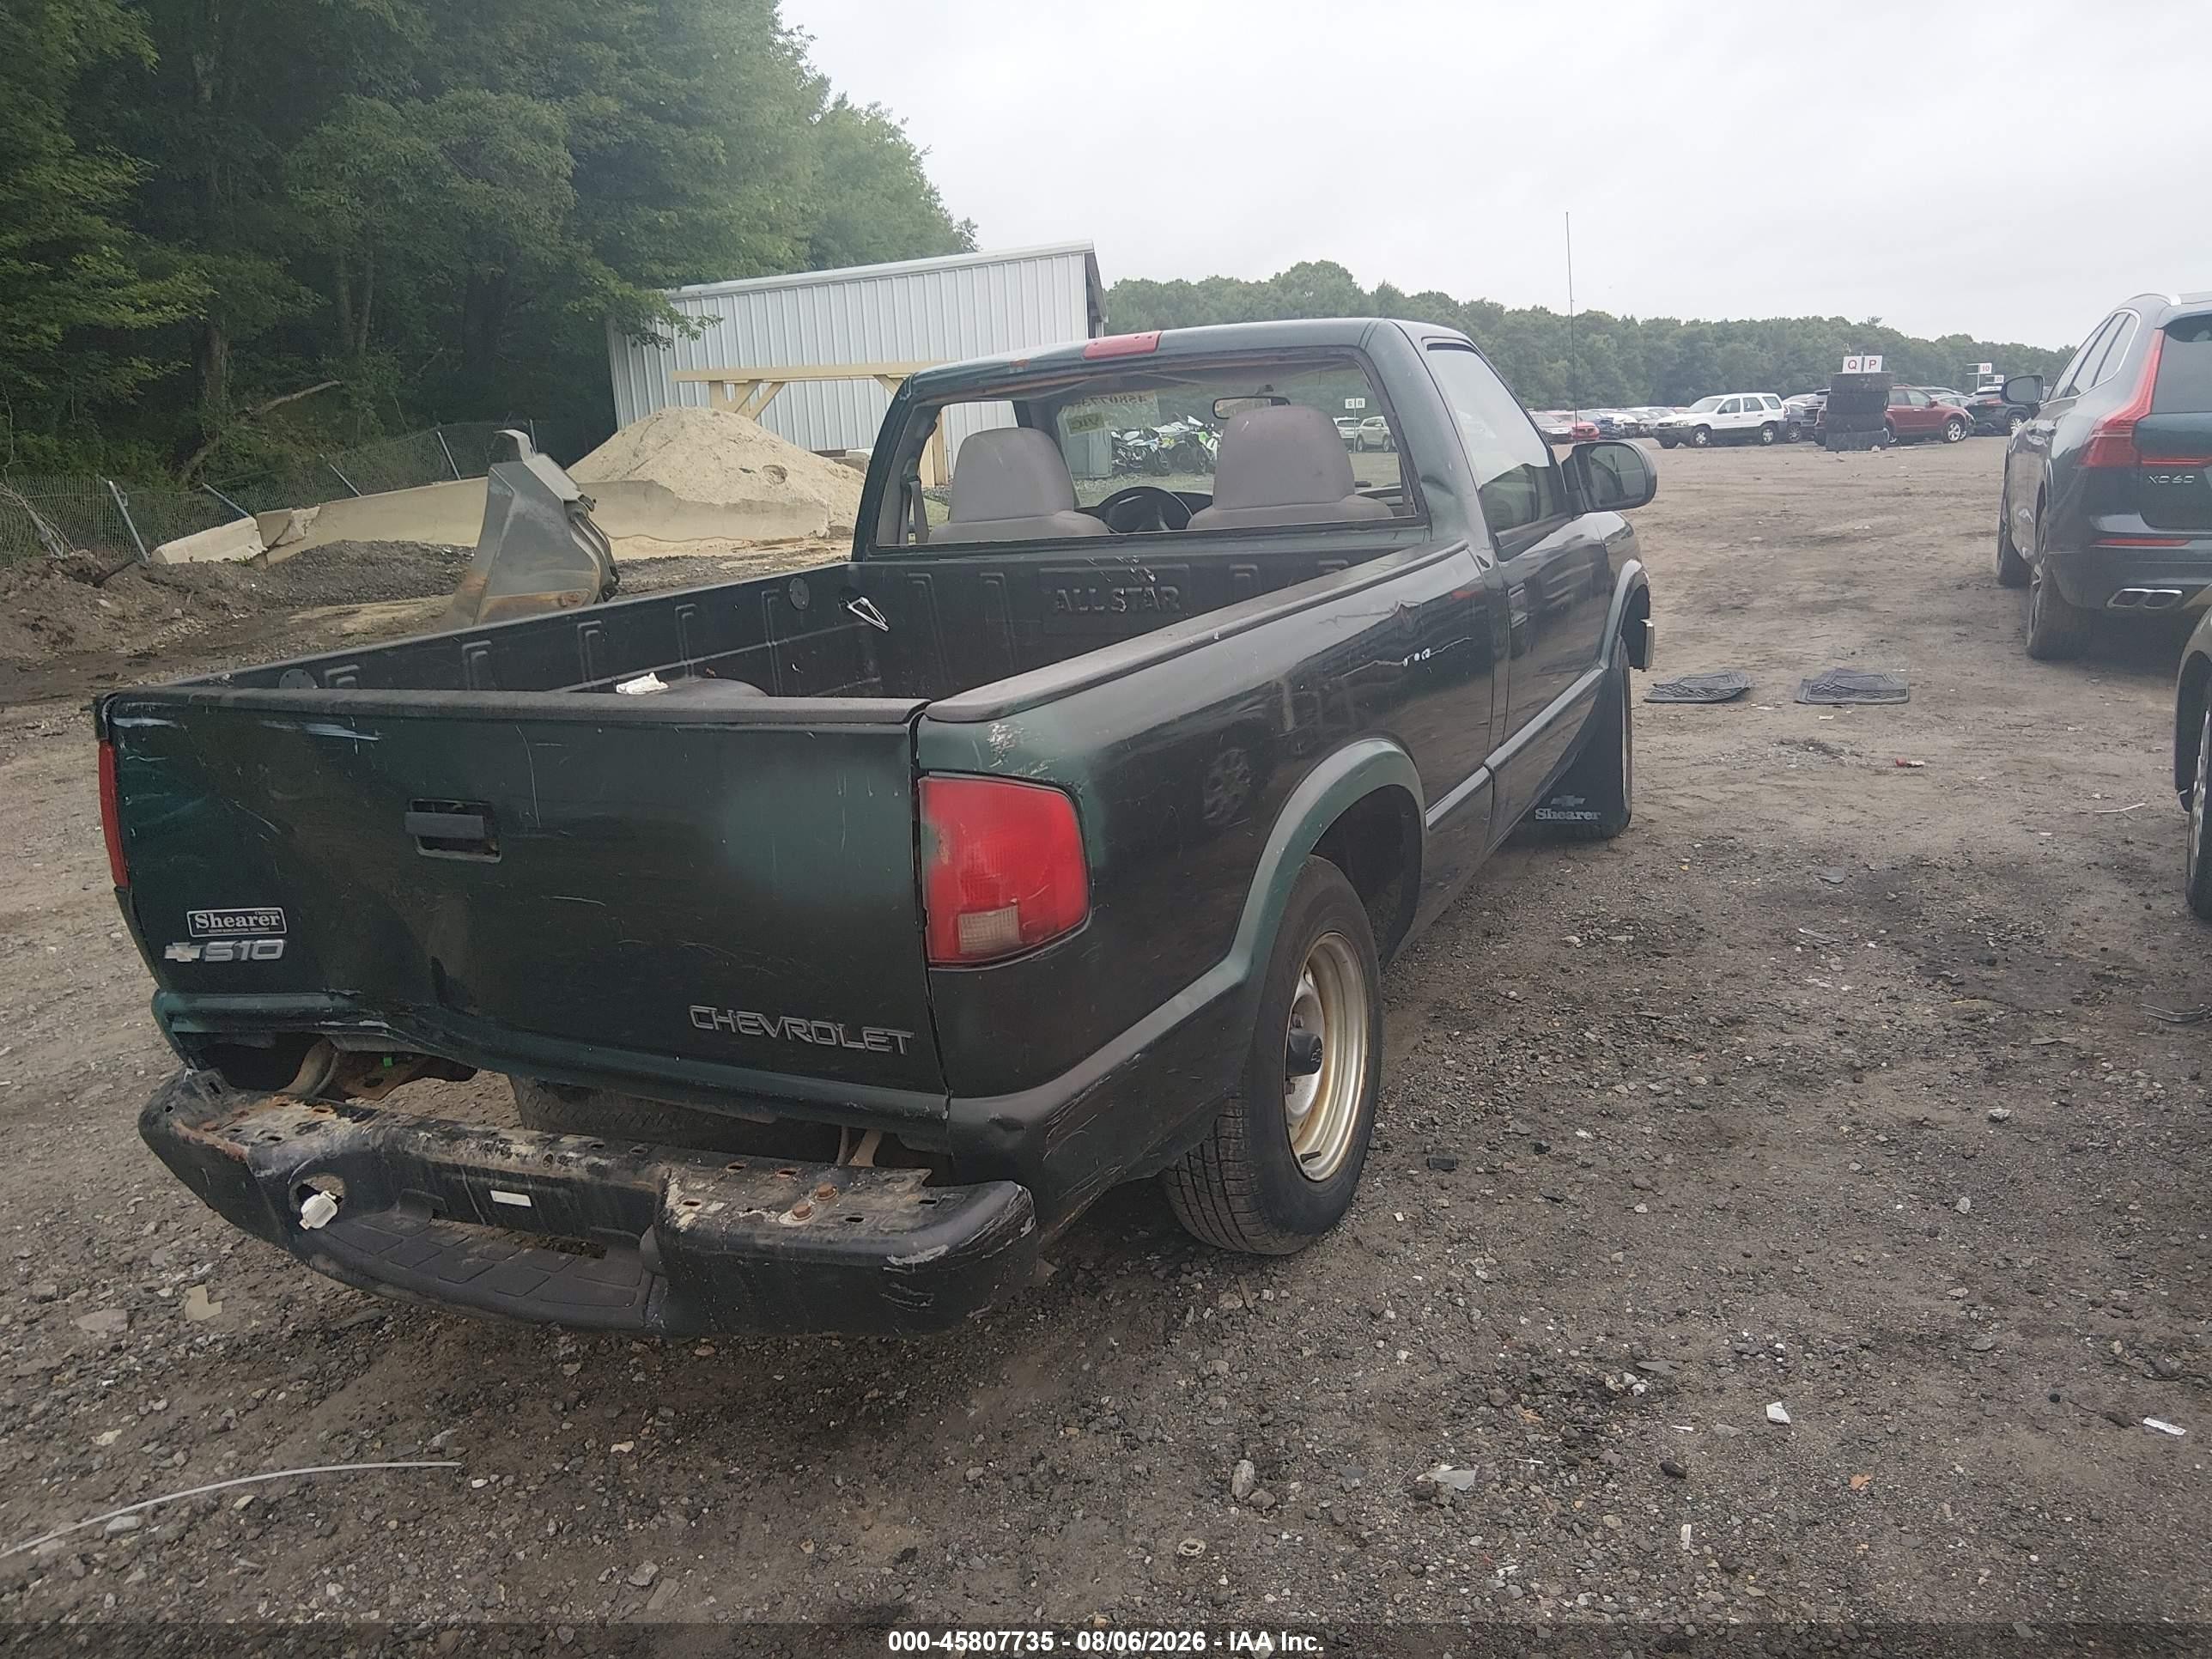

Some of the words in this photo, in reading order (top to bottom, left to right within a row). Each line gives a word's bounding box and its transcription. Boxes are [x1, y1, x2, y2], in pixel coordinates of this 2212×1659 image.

[1848, 359, 1857, 370] Q
[1869, 359, 1876, 369] P
[1534, 808, 1601, 820] Shearer
[194, 913, 280, 928] Shearer
[204, 939, 284, 962] S10
[690, 1005, 915, 1055] CHEVROLET
